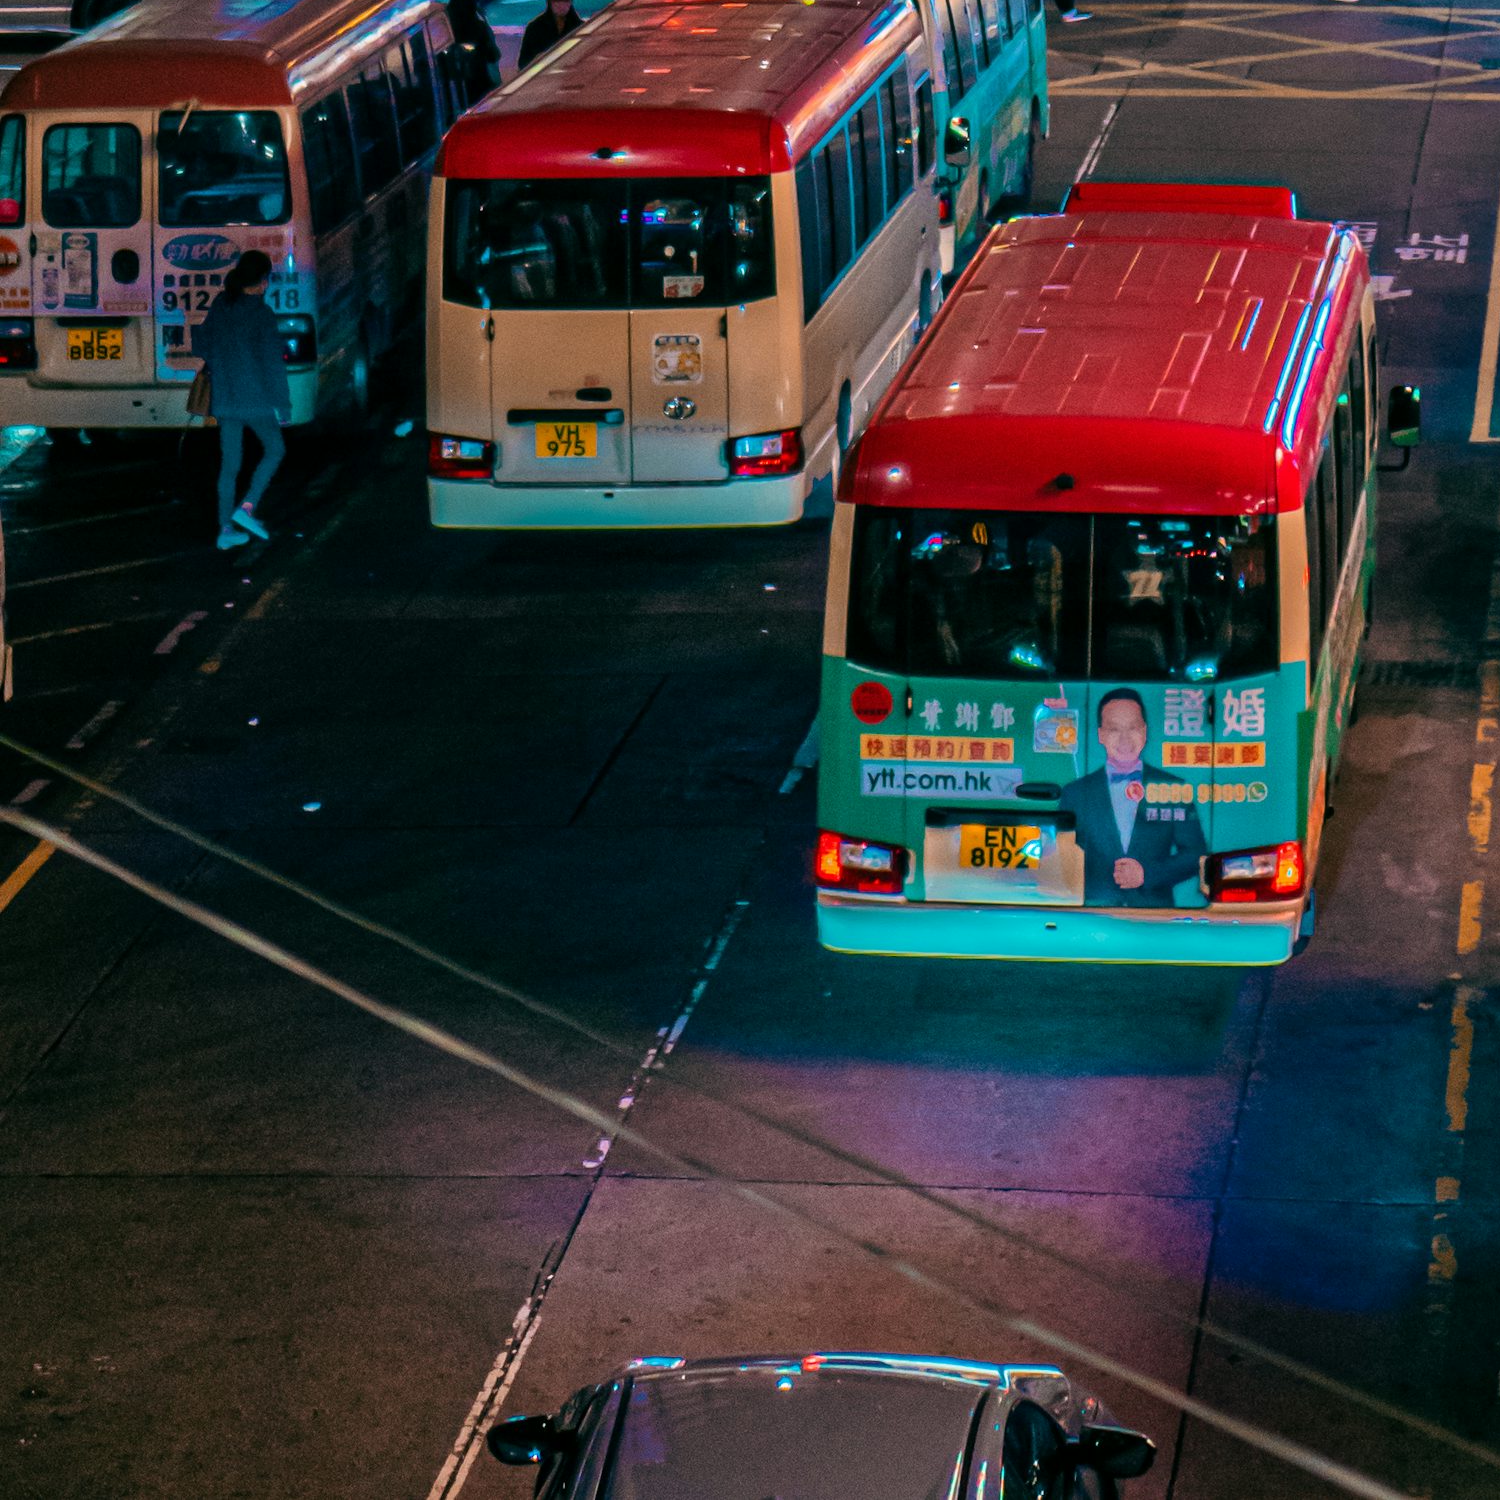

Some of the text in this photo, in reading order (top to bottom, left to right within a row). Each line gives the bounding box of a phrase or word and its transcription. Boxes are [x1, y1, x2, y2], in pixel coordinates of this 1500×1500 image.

[554, 424, 581, 441] VH
[546, 440, 587, 457] 975
[1163, 687, 1267, 738] 證婚
[867, 768, 993, 794] ytt.com.hk
[984, 825, 1018, 849] EN
[970, 847, 1031, 869] 8192
